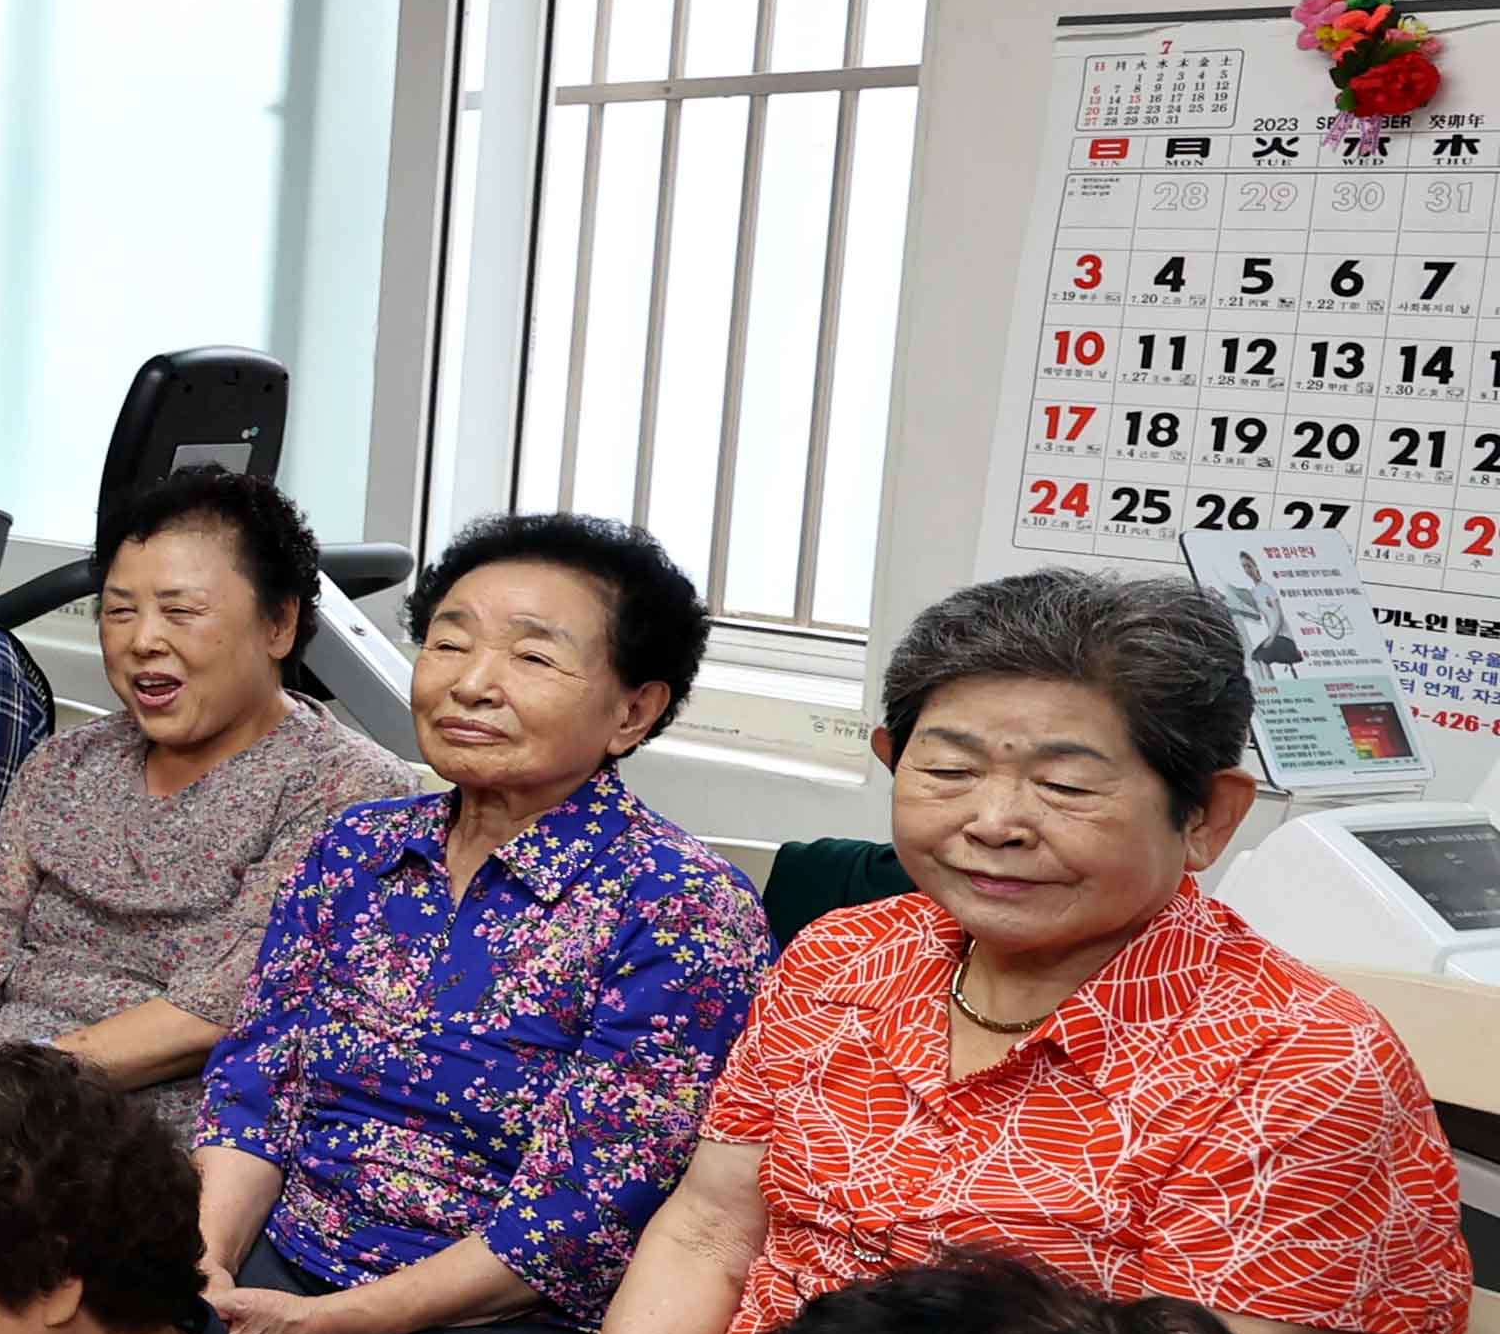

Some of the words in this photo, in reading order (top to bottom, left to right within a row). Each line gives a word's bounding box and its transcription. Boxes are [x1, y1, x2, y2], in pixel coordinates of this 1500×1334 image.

[1172, 82, 1186, 91] 10
[1216, 81, 1230, 90] 12
[1214, 92, 1228, 101] 19
[1211, 103, 1228, 113] 26
[1252, 117, 1299, 132] 2023
[1088, 138, 1130, 159] 日
[1165, 137, 1211, 159] 月
[1251, 136, 1300, 159] 火
[1432, 133, 1481, 157] 木
[1165, 159, 1204, 167] MON
[1256, 158, 1291, 167] TUE
[1342, 158, 1385, 166] WED
[1436, 157, 1473, 166] THU
[1152, 181, 1209, 211] 28
[1238, 181, 1299, 212] 29
[1331, 181, 1386, 212] 30
[1425, 181, 1474, 213] 31
[1073, 253, 1103, 290] 3
[1153, 256, 1186, 293] 4
[1240, 258, 1274, 295] 5
[1330, 260, 1364, 298] 6
[1420, 262, 1457, 300] 7
[1054, 330, 1106, 366] 10
[1138, 334, 1187, 371] 11
[1221, 337, 1278, 376] 12
[1311, 341, 1365, 380] 13
[1400, 345, 1455, 385] 14
[1044, 405, 1098, 441] 17
[1125, 410, 1180, 448] 18
[1210, 416, 1268, 454] 19
[1292, 421, 1361, 461] 20
[1388, 427, 1447, 469] 21
[1028, 479, 1090, 518] 24
[1110, 486, 1172, 525] 25
[1194, 493, 1260, 531] 26
[1372, 507, 1441, 550] 28
[1411, 642, 1448, 661] 자살
[1436, 665, 1474, 683] 이상
